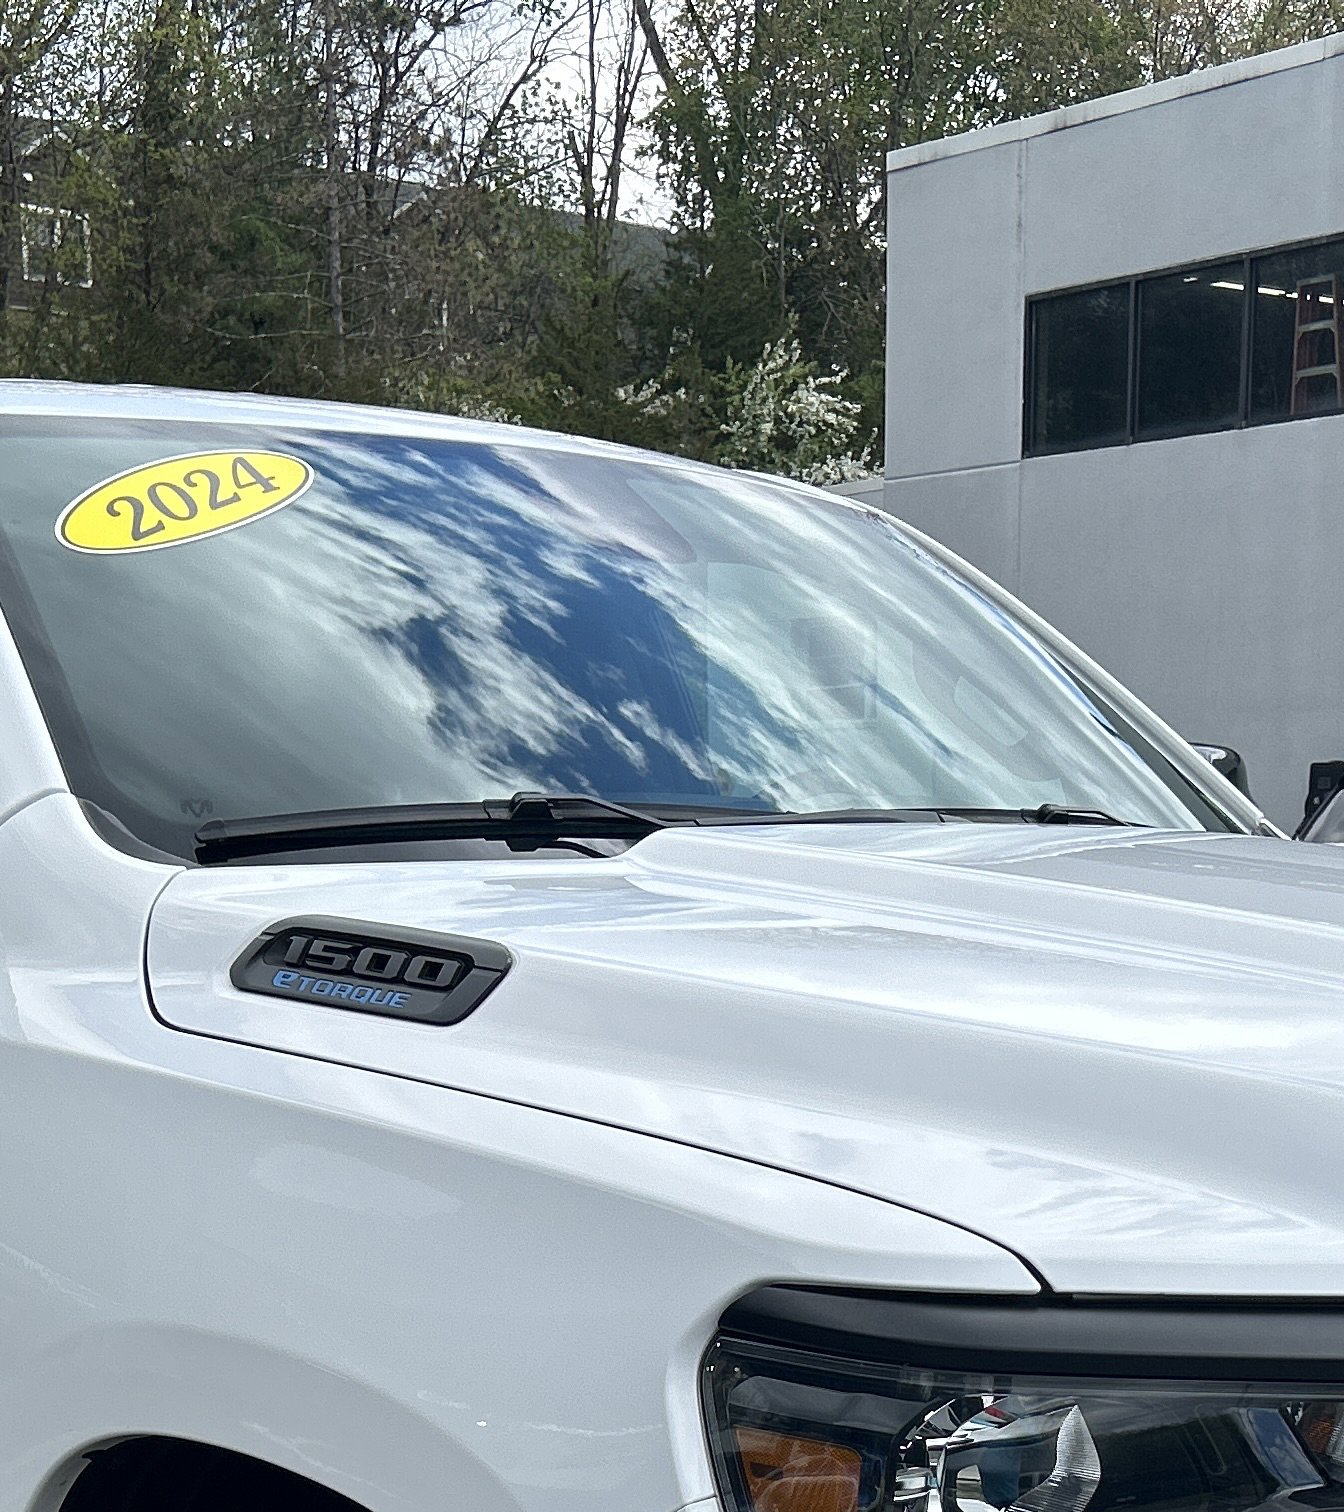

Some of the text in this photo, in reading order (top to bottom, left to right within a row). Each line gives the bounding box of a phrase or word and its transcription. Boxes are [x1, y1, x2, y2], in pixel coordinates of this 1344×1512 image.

[106, 457, 280, 541] 2024
[281, 935, 462, 987] 1500
[272, 970, 412, 1009] eTORQUE
